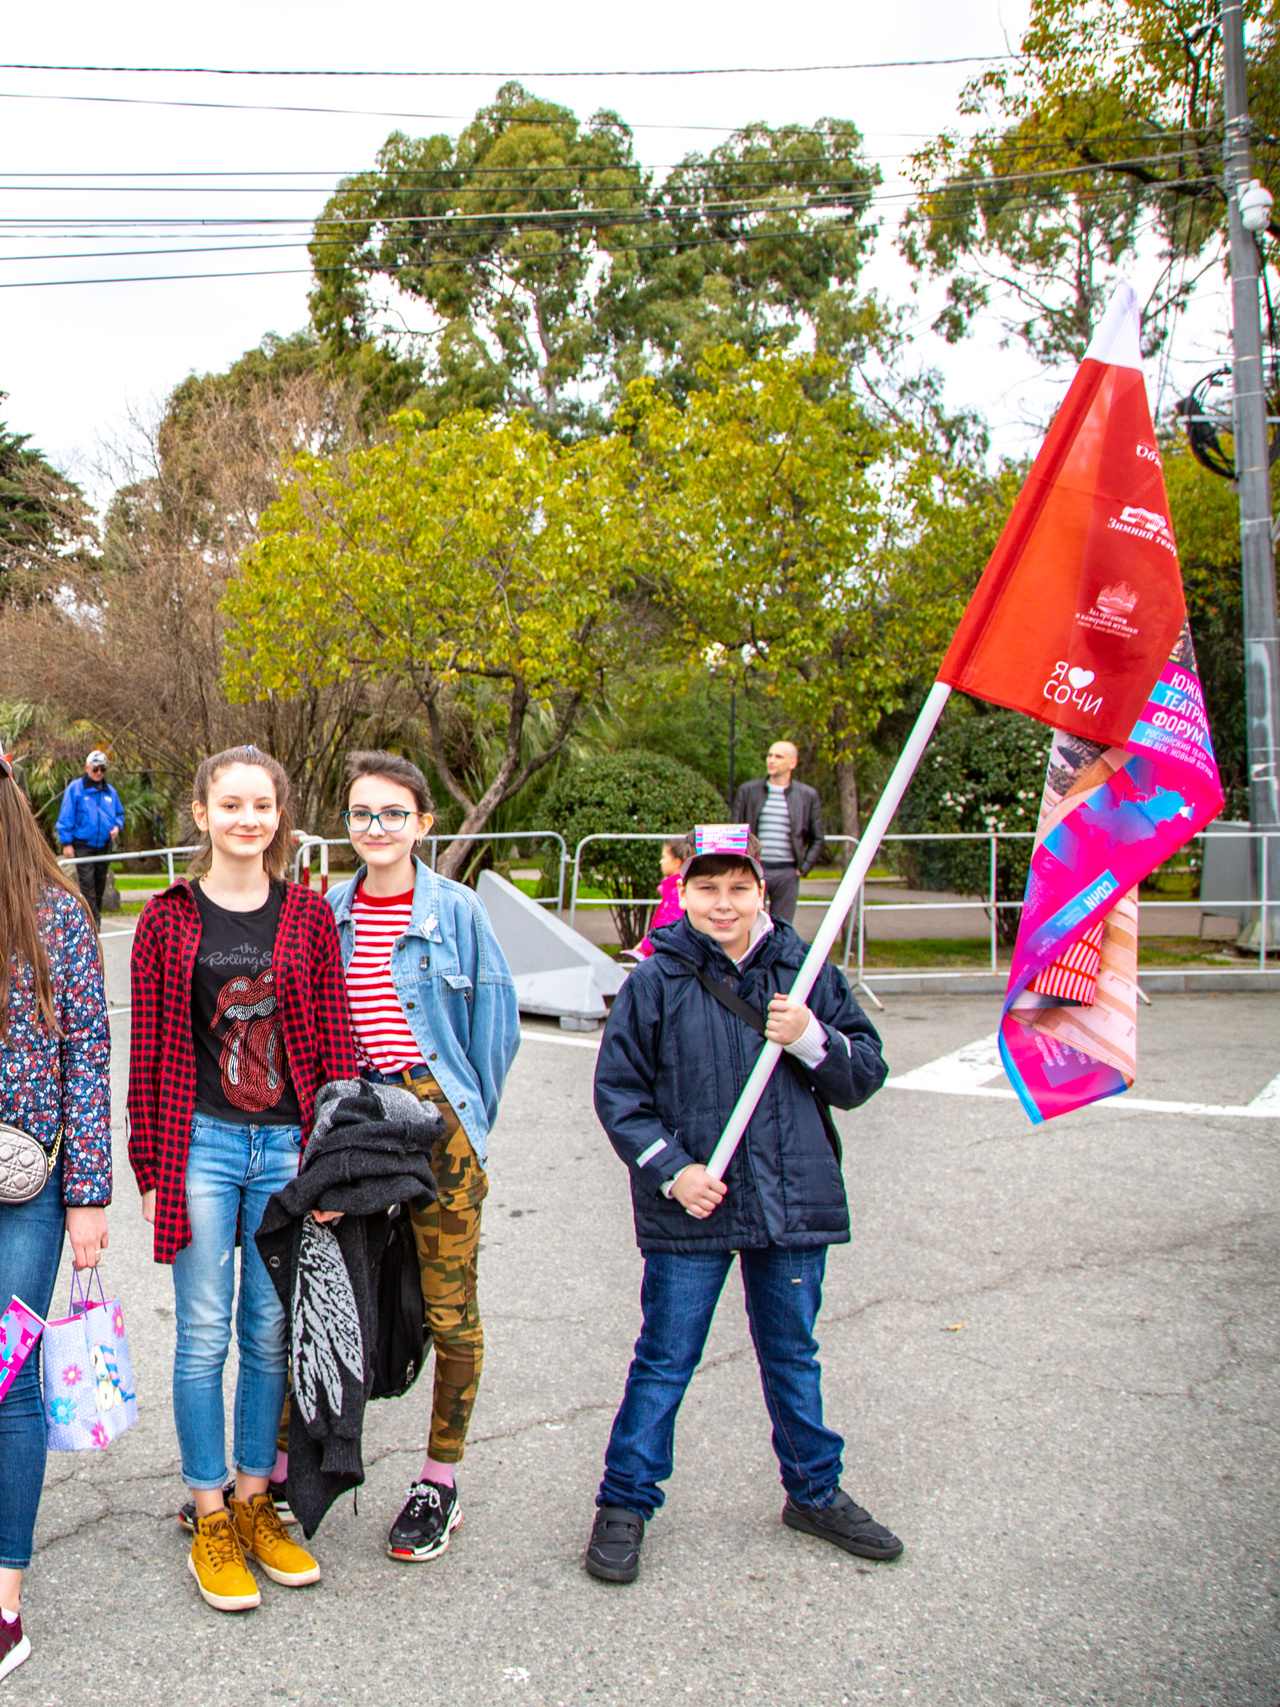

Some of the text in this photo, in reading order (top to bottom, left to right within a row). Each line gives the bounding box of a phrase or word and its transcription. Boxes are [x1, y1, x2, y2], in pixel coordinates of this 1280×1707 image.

[1107, 517, 1155, 541] Зимний
[1051, 661, 1070, 681] Я
[1043, 680, 1104, 716] СОЧИ
[1152, 710, 1204, 746] ФОРУМ
[1145, 728, 1192, 752] РОССИЙСКИЙ
[1170, 746, 1196, 765] НОВЫЙ
[231, 942, 260, 954] the
[199, 951, 273, 973] Rolling S
